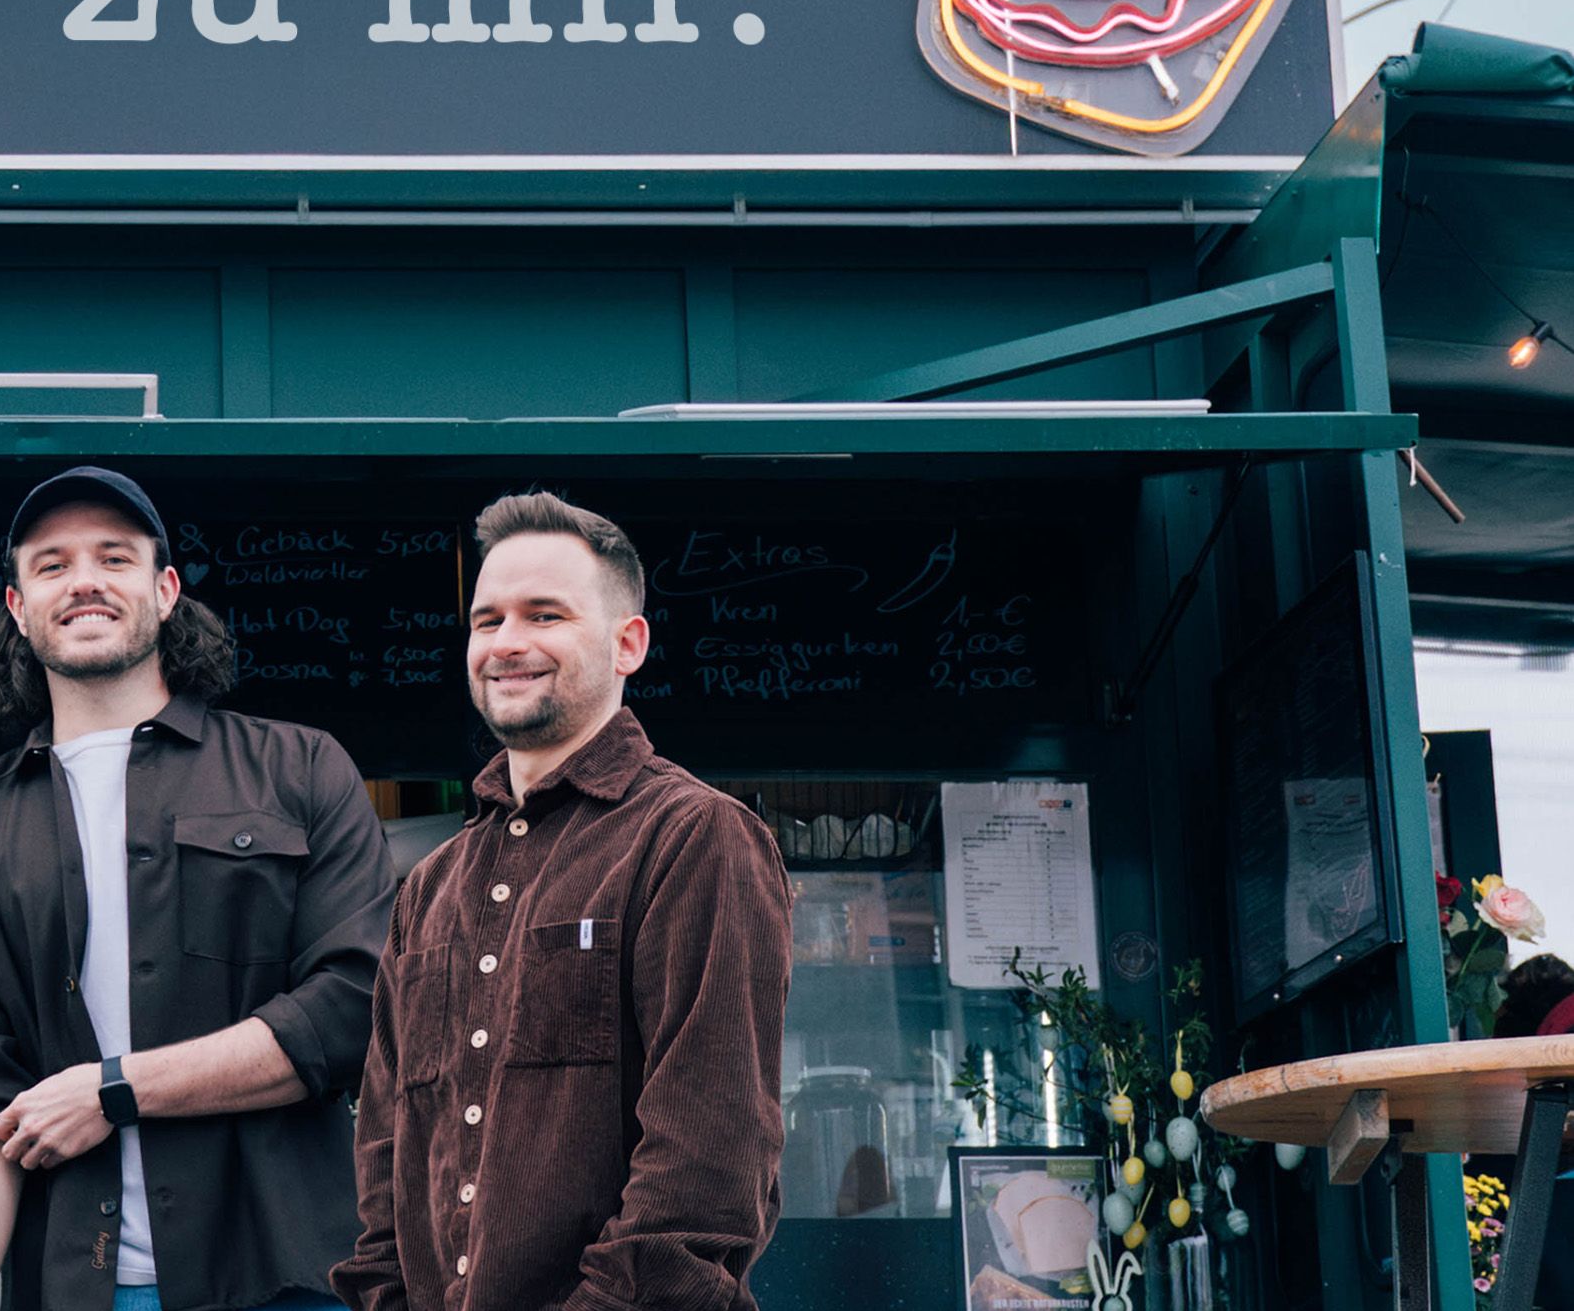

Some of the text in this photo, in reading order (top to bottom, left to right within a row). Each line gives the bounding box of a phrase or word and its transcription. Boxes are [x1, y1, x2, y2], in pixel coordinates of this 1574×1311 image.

[178, 523, 210, 555] &
[235, 525, 355, 557] Gebäck
[677, 530, 829, 576] Extras
[225, 560, 370, 586] Waldviertler
[226, 606, 281, 634] Hot
[285, 606, 352, 644] Dog
[709, 595, 779, 624] Kren
[232, 647, 336, 682] Bosna
[693, 630, 900, 672] Essiggurken
[693, 662, 863, 702] Pfefferoni
